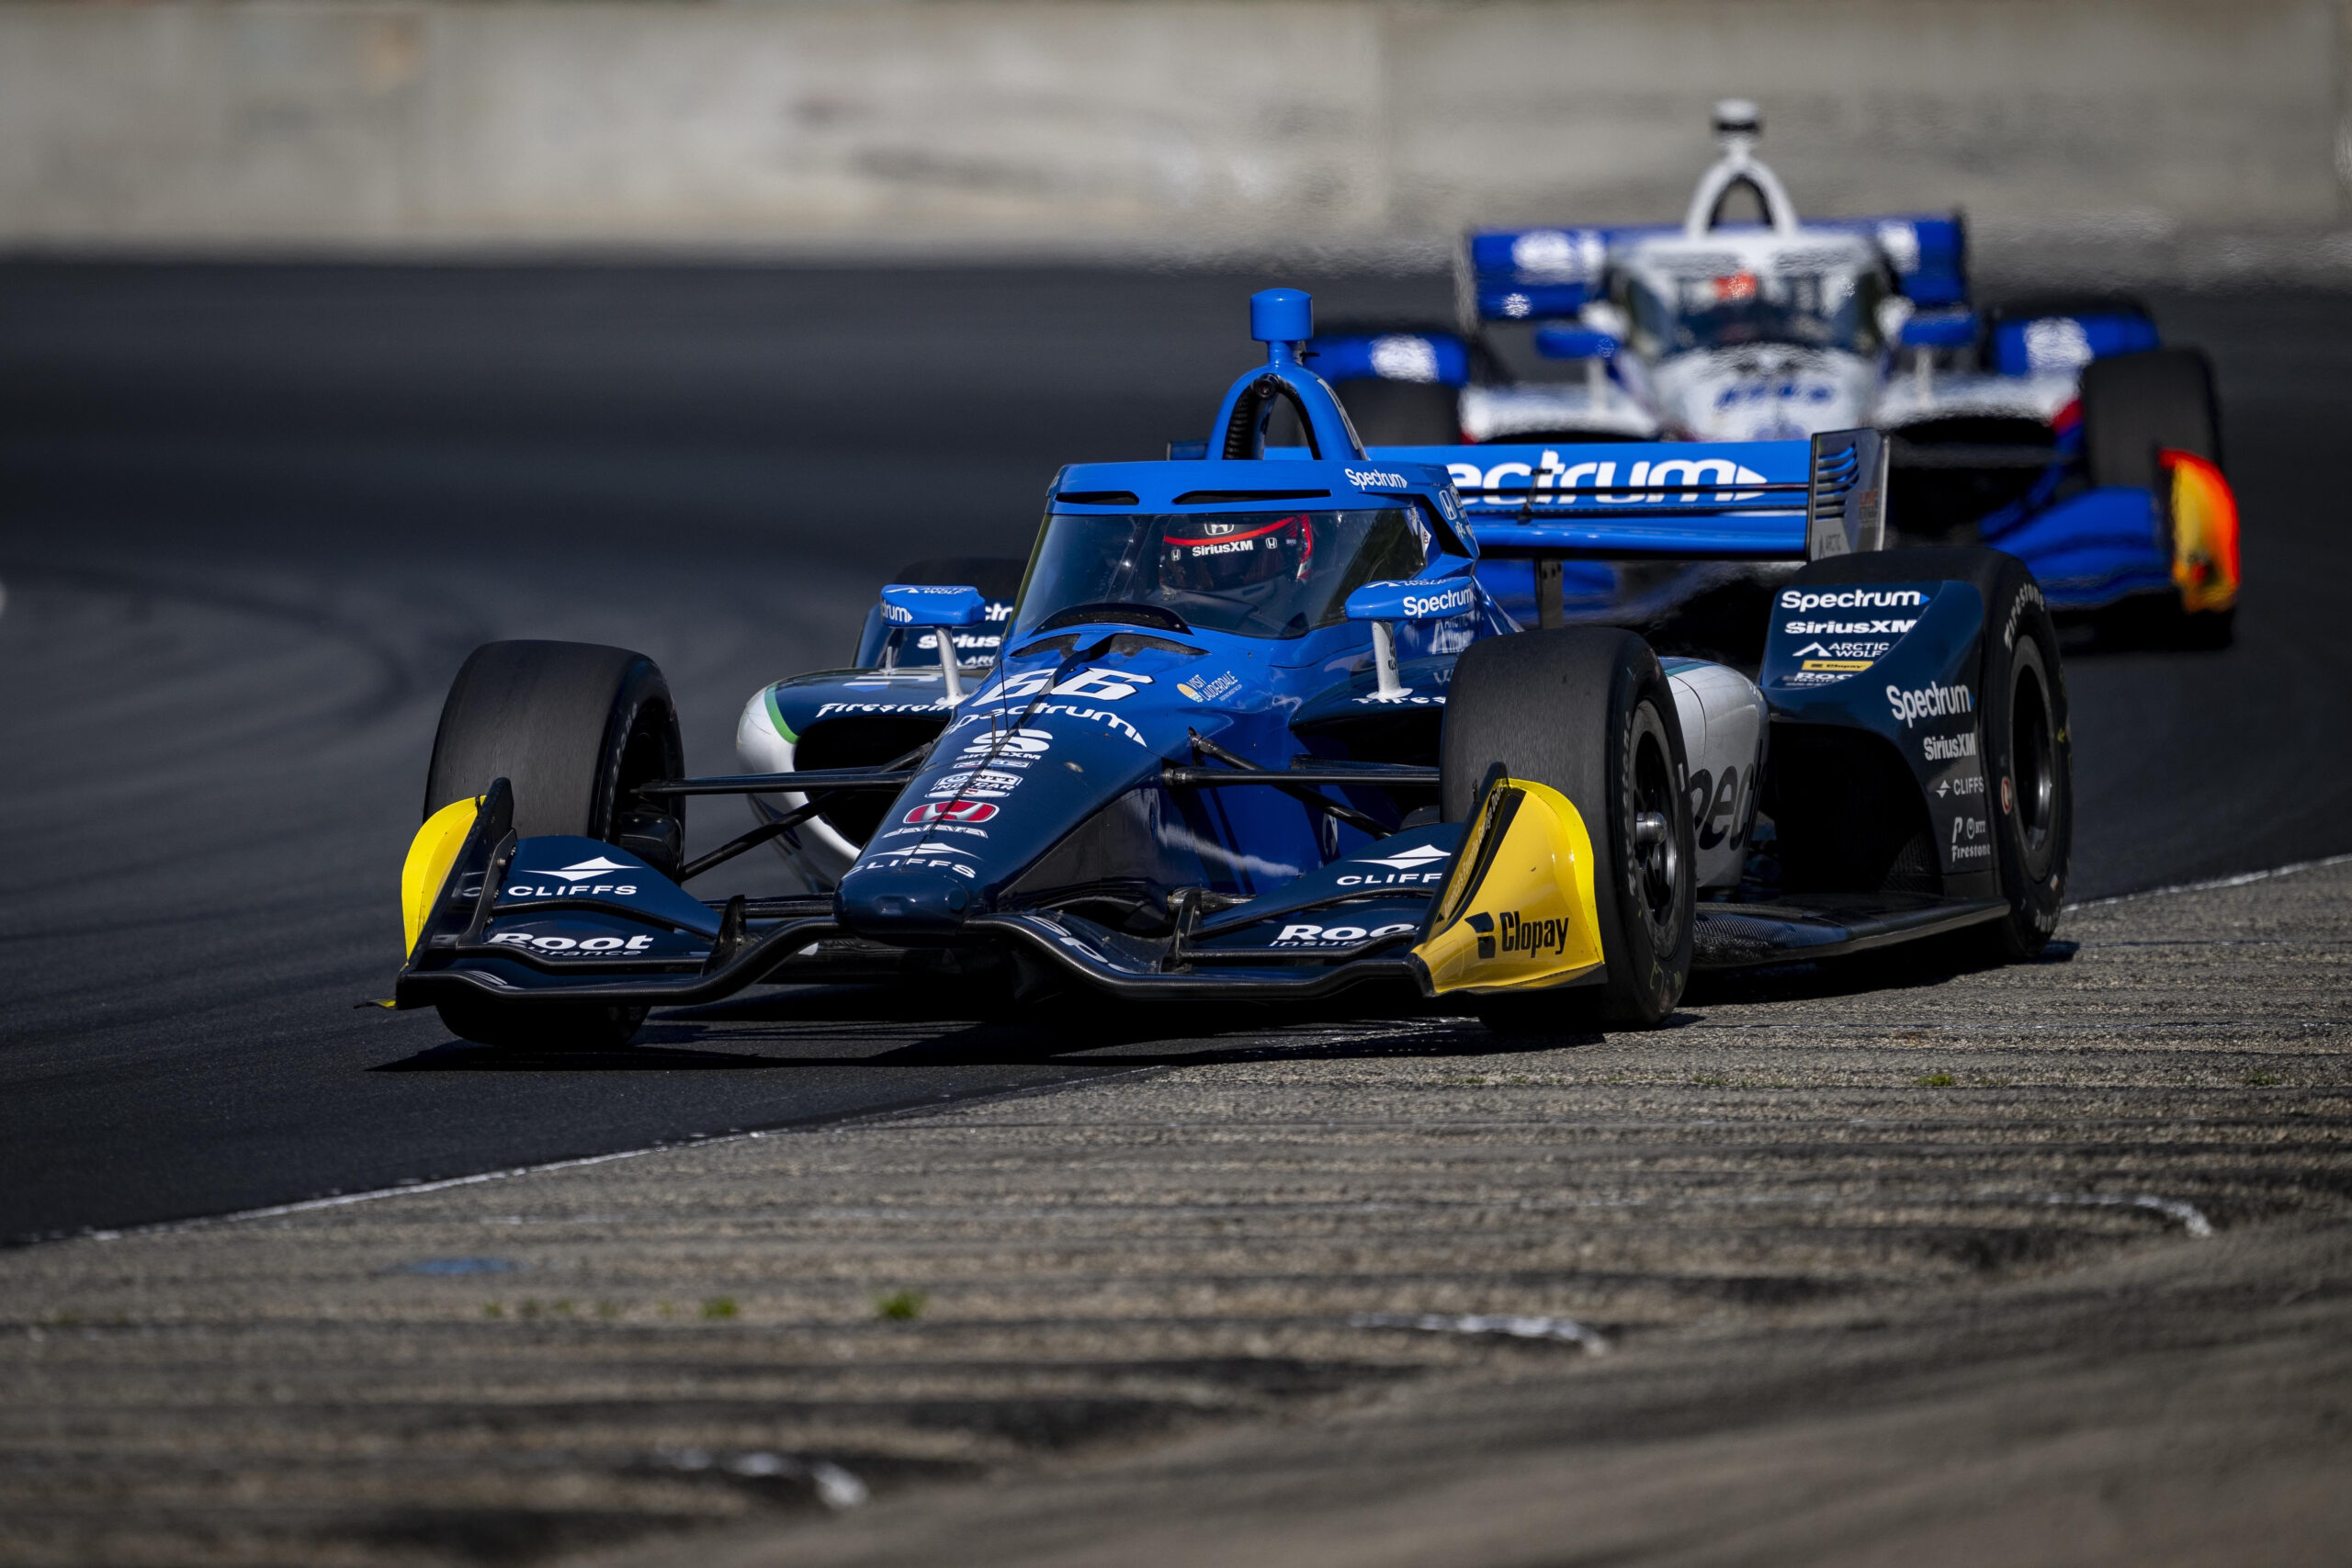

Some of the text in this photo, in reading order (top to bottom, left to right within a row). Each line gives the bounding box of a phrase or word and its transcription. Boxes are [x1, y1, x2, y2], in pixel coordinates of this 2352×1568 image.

[1345, 468, 1405, 491] Spectrum
[1445, 450, 1736, 504] ectrum
[1192, 539, 1253, 557] SiriusXM
[1403, 589, 1472, 618] Spectrum
[1781, 589, 1921, 613] Spectrum
[1784, 620, 1917, 634] SiriusXM
[1828, 642, 1889, 650] ARCTIC
[1185, 673, 1207, 690] VISIT
[1197, 671, 1238, 701] LAUDERDALE
[1886, 681, 1971, 728] Spectrum
[1923, 732, 1976, 761] SiriusXM
[1953, 776, 1984, 795] CLIFFS
[1951, 844, 1991, 863] Firestone
[842, 858, 977, 879] CLIFFS
[1337, 873, 1442, 886] CLIFF
[508, 885, 638, 897] CLIFFS
[482, 932, 654, 951] Root
[1499, 910, 1569, 958] Clopay
